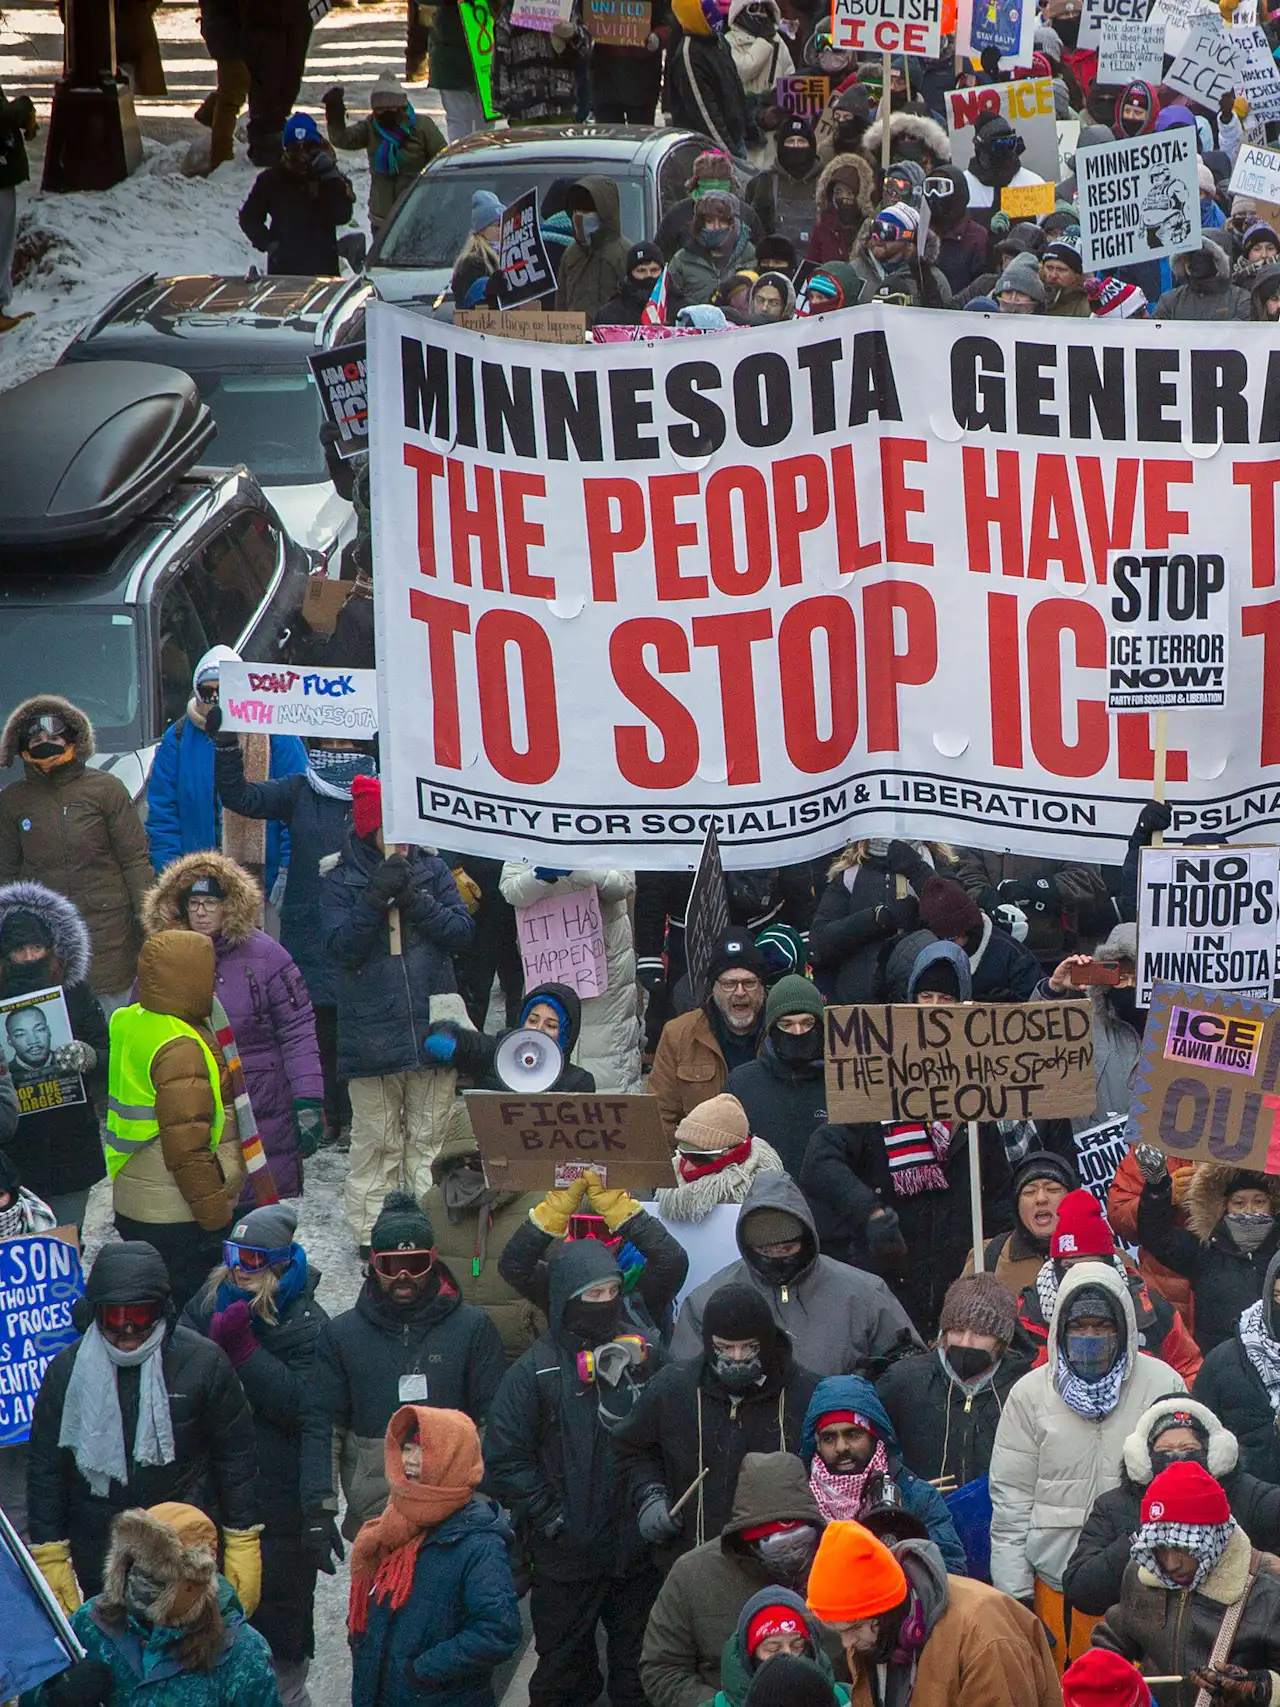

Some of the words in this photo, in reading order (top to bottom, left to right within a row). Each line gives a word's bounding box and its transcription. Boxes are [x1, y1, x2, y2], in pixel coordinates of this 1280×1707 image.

[835, 0, 939, 22] ABOLISH
[839, 19, 930, 53] ICE
[1195, 36, 1240, 69] FUCK
[782, 79, 825, 93] ICE
[1171, 56, 1230, 100] ICE
[951, 88, 1002, 131] NO
[1007, 80, 1054, 120] ICE
[1085, 140, 1188, 179] MINNESOTA:
[1087, 176, 1141, 206] RESIST
[1089, 203, 1140, 234] DEFEND
[1091, 230, 1135, 261] FIGHT
[400, 330, 904, 463] MINNESOTA
[402, 443, 556, 601] THE
[582, 437, 935, 604] PEOPLE
[961, 445, 1195, 583] HAVE
[1111, 553, 1225, 623] STOP
[1110, 635, 1142, 665] ICE
[1147, 633, 1224, 665] TERROR
[302, 674, 356, 697] FUCK
[408, 587, 562, 786] TO
[608, 579, 939, 790] STOP
[1109, 667, 1224, 689] NOW!
[228, 699, 275, 724] WITH
[277, 703, 378, 729] MINNESOTA
[430, 790, 541, 830] PARTY
[550, 812, 630, 836] FOR
[641, 788, 848, 836] SOCIALISM
[852, 782, 871, 804] &
[879, 778, 1098, 828] LIBERATION
[1175, 857, 1248, 883] NO
[1147, 879, 1273, 927] TROOPS
[523, 914, 556, 944] IT
[562, 898, 598, 938] HAS
[1192, 935, 1224, 952] IN
[1144, 949, 1270, 984] MINNESOTA
[827, 1005, 894, 1056] MN
[917, 1007, 954, 1050] IS
[963, 1005, 1090, 1048] CLOSED
[1175, 1011, 1263, 1050] ICE
[1171, 1037, 1213, 1064] TAWM
[1215, 1046, 1252, 1070] MUS!
[37, 1079, 61, 1096] THE
[891, 1084, 953, 1121] ICE
[500, 1101, 628, 1127] FIGHT
[520, 1128, 628, 1151] BACK
